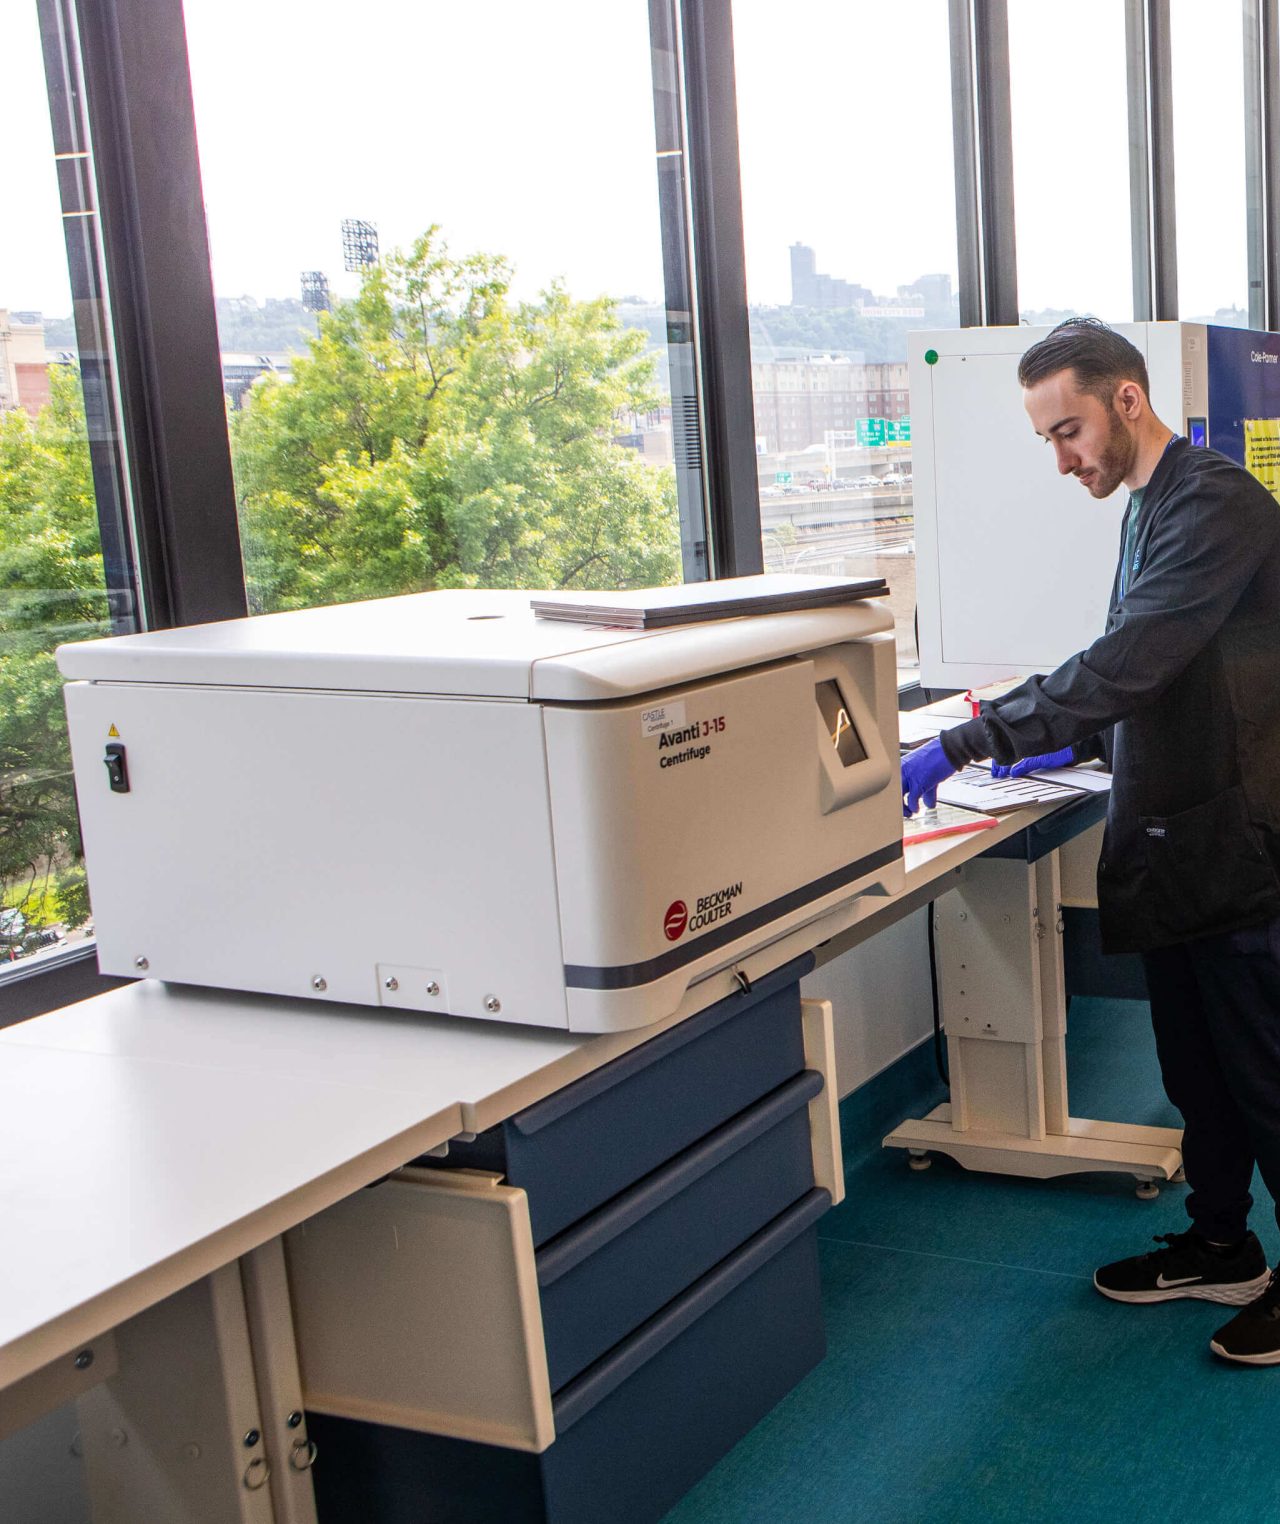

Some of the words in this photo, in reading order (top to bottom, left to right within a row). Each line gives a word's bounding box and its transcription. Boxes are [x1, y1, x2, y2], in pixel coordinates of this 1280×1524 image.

[642, 708, 665, 721] CASTLE
[659, 721, 700, 749] Avanti
[702, 716, 725, 736] J-15
[660, 745, 711, 768] Centrifuge
[696, 881, 742, 914] BECKMAN
[688, 901, 731, 932] COULTER
